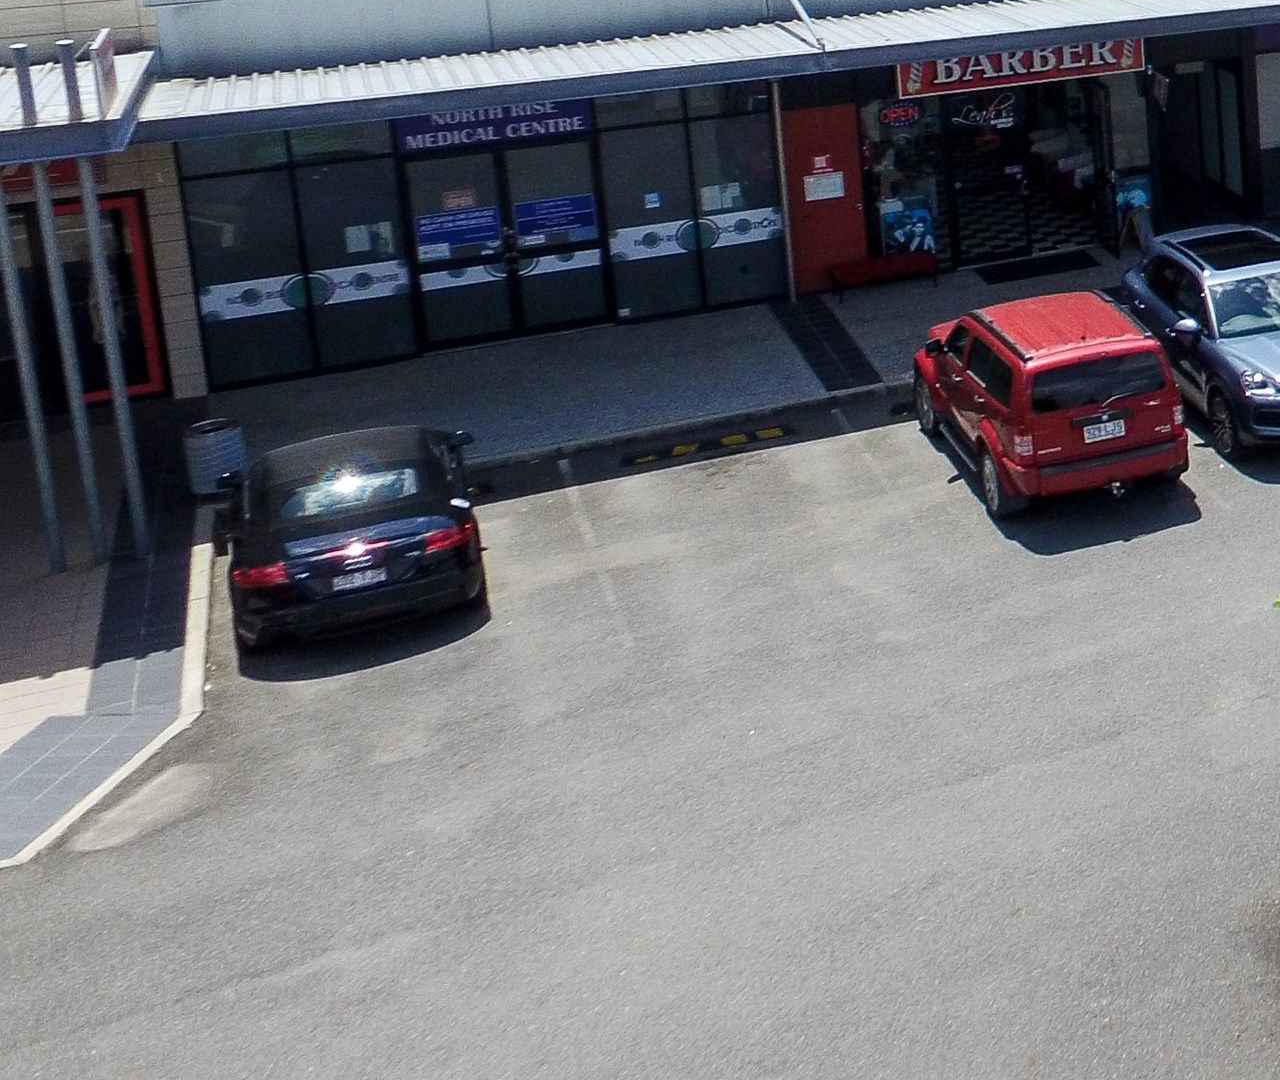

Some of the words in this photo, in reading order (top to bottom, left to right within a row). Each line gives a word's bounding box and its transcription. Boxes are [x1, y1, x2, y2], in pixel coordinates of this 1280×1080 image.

[933, 40, 1118, 84] BARBER
[431, 104, 503, 126] NORTH
[511, 100, 559, 118] RISE
[880, 105, 920, 124] OPEN
[406, 125, 501, 149] MEDICAL
[505, 116, 586, 138] CENTRE
